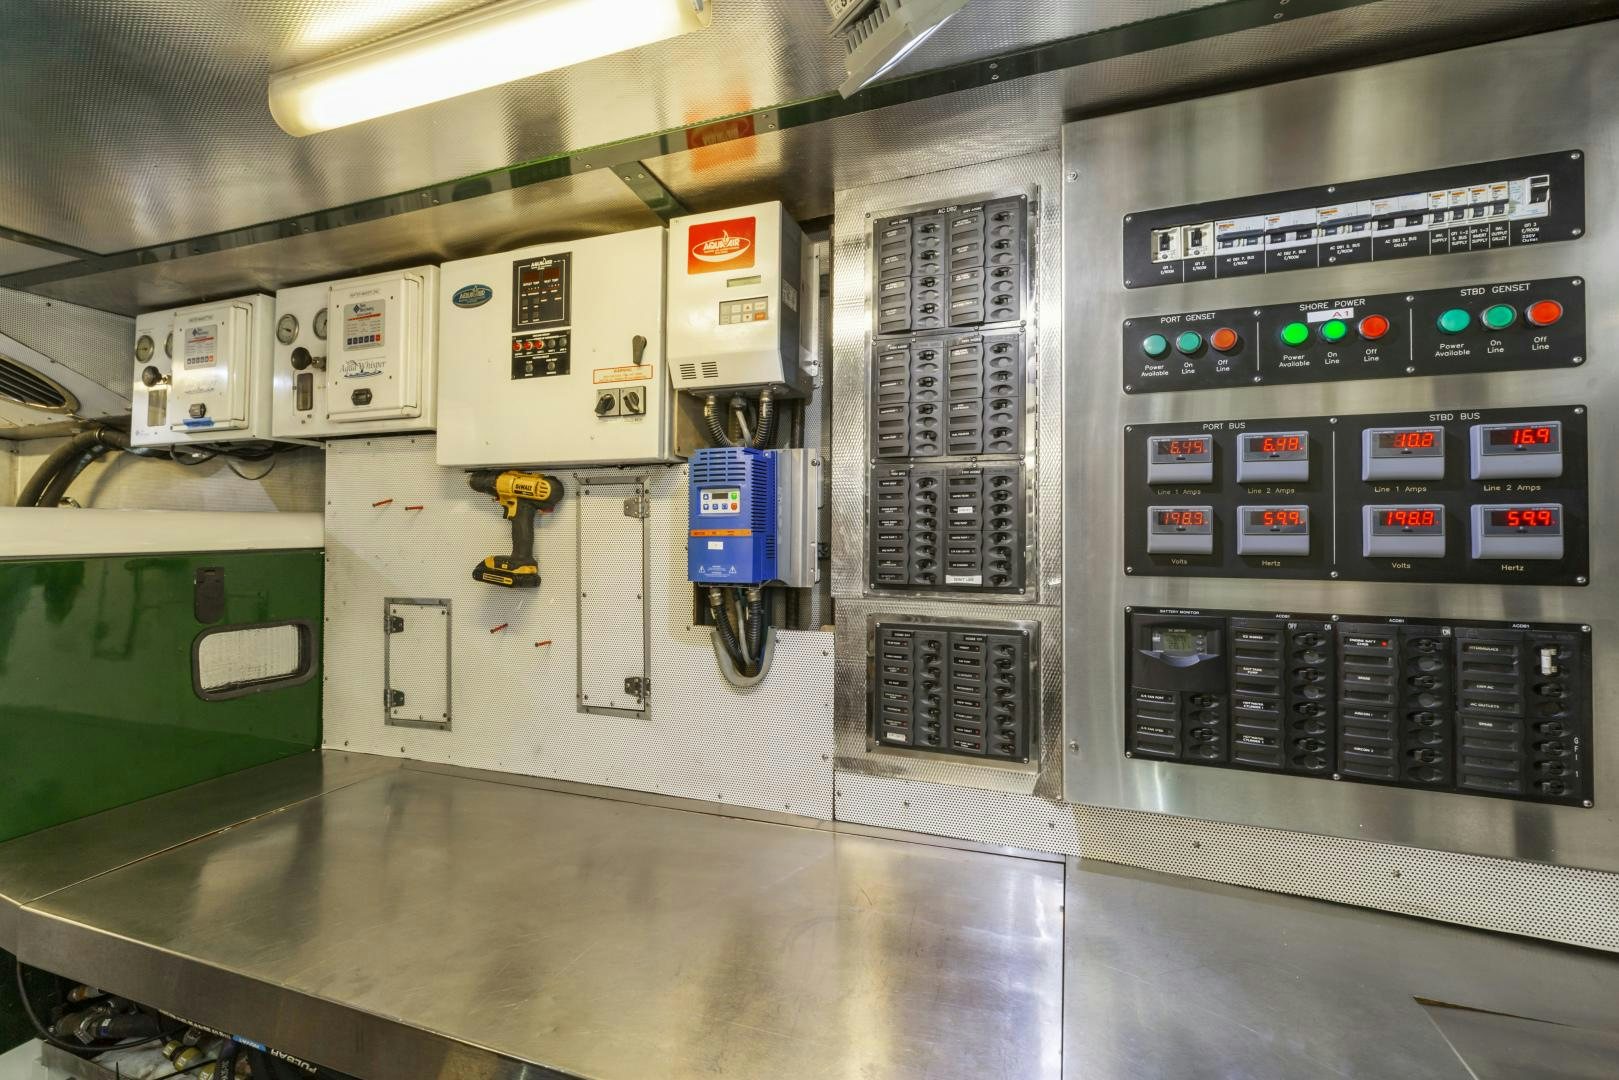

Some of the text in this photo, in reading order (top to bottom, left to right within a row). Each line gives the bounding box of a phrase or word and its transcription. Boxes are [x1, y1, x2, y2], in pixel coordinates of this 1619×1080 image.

[1460, 283, 1531, 296] STBD GENSET
[1299, 298, 1366, 311] SHORE POWER
[1161, 312, 1216, 324] PORT GENSET
[1435, 349, 1470, 357] Available
[1405, 485, 1427, 493] Amps
[1517, 484, 1541, 492] Amps
